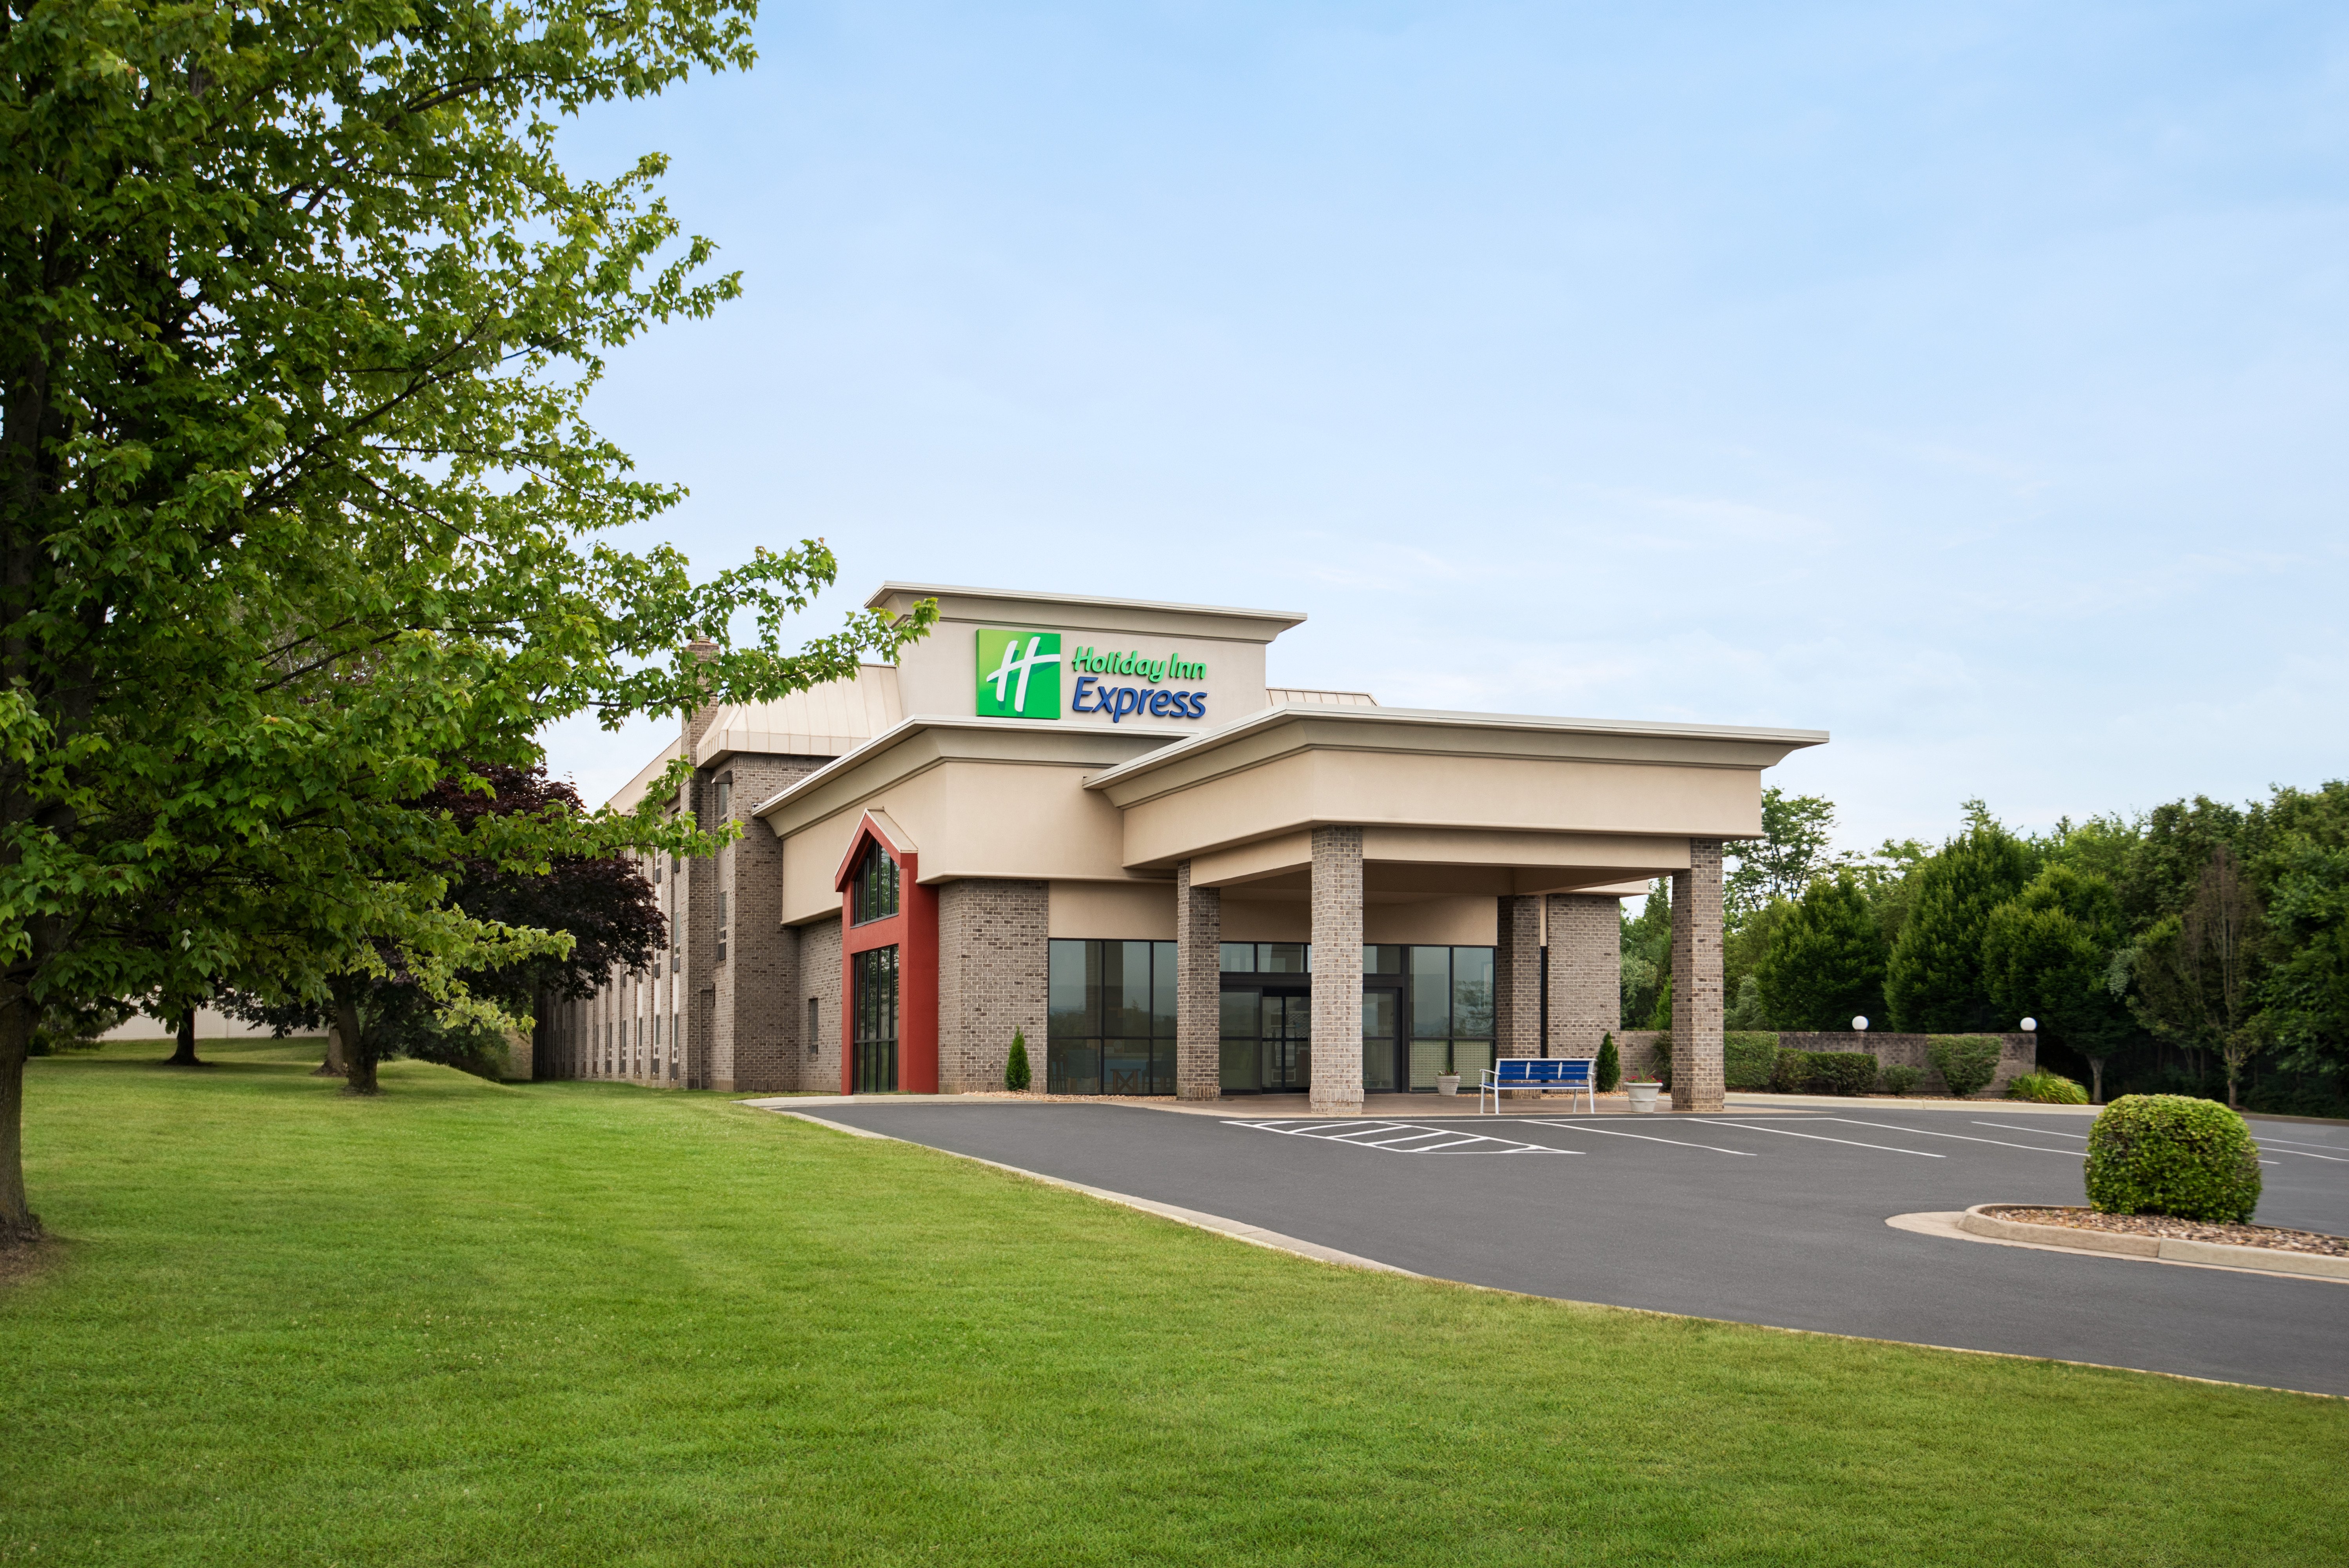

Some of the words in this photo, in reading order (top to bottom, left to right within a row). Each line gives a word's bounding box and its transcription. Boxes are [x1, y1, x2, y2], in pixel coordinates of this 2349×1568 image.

[1072, 646, 1167, 682] Holiday
[1169, 653, 1207, 679] Inn
[1072, 676, 1207, 723] Express
